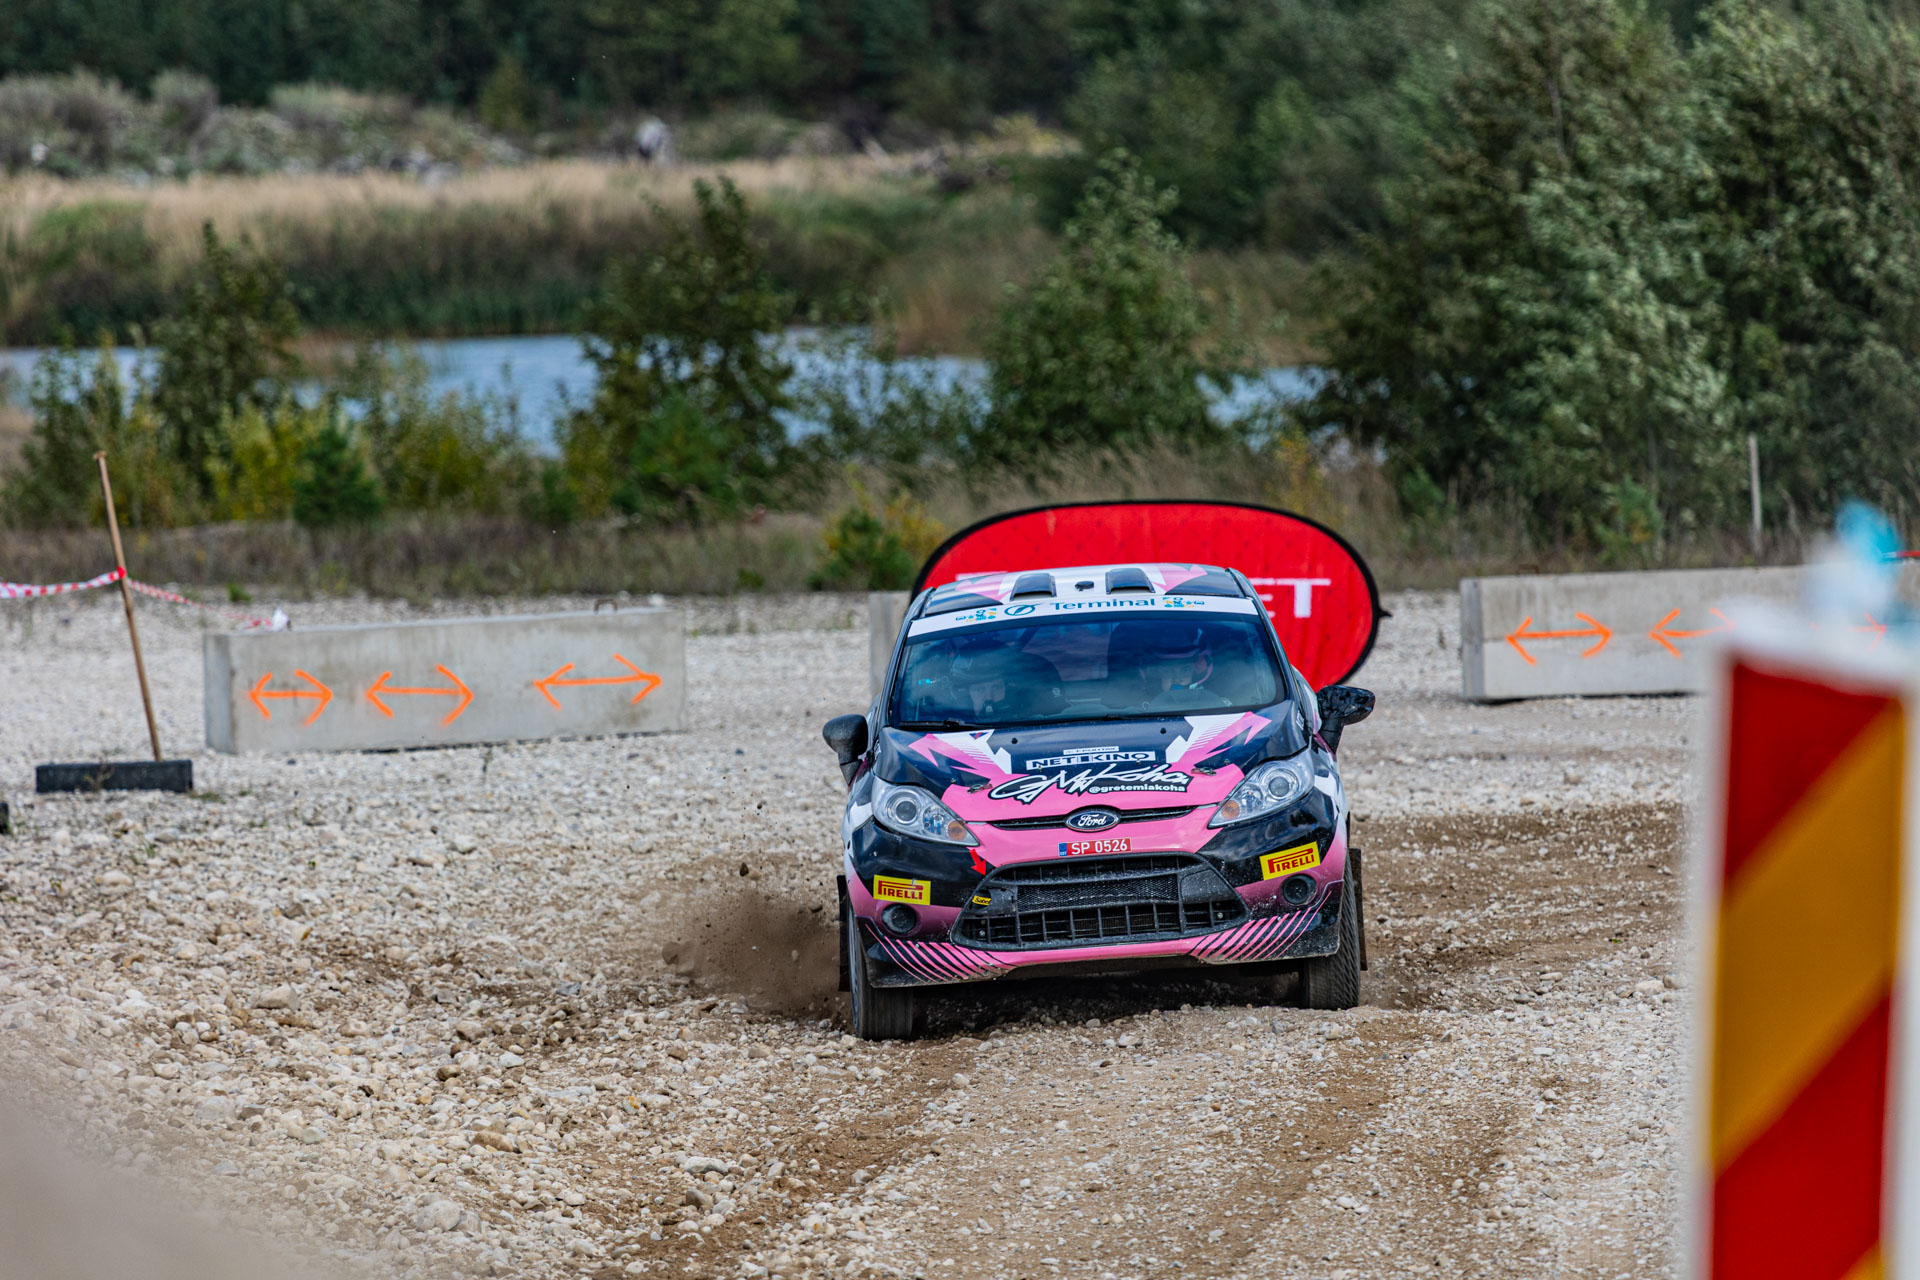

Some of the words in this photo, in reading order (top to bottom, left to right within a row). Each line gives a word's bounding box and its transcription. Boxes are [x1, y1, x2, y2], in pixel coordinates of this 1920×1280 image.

[1051, 598, 1156, 611] Terminal
[1089, 783, 1186, 794] @gretemiakoha
[1077, 813, 1107, 827] Ford
[1071, 842, 1090, 855] SP
[1094, 839, 1128, 853] 0526
[1267, 847, 1315, 874] PIRELLI
[877, 880, 924, 900] PIRELLI
